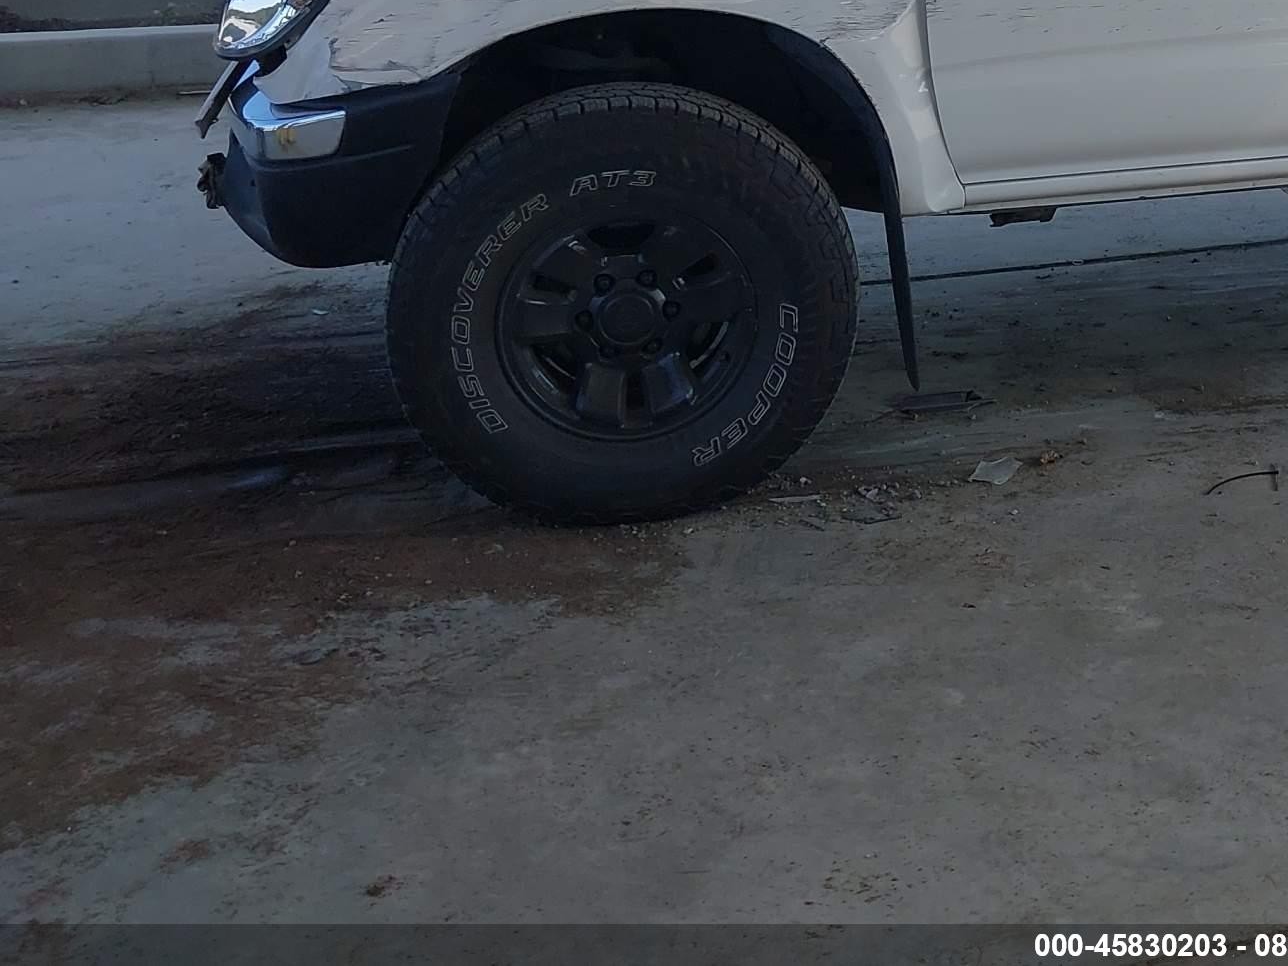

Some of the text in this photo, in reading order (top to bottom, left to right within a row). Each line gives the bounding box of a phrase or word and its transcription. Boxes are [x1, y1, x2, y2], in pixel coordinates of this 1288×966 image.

[450, 170, 657, 435] DISCOVERER AT3
[691, 303, 800, 467] COOPER
